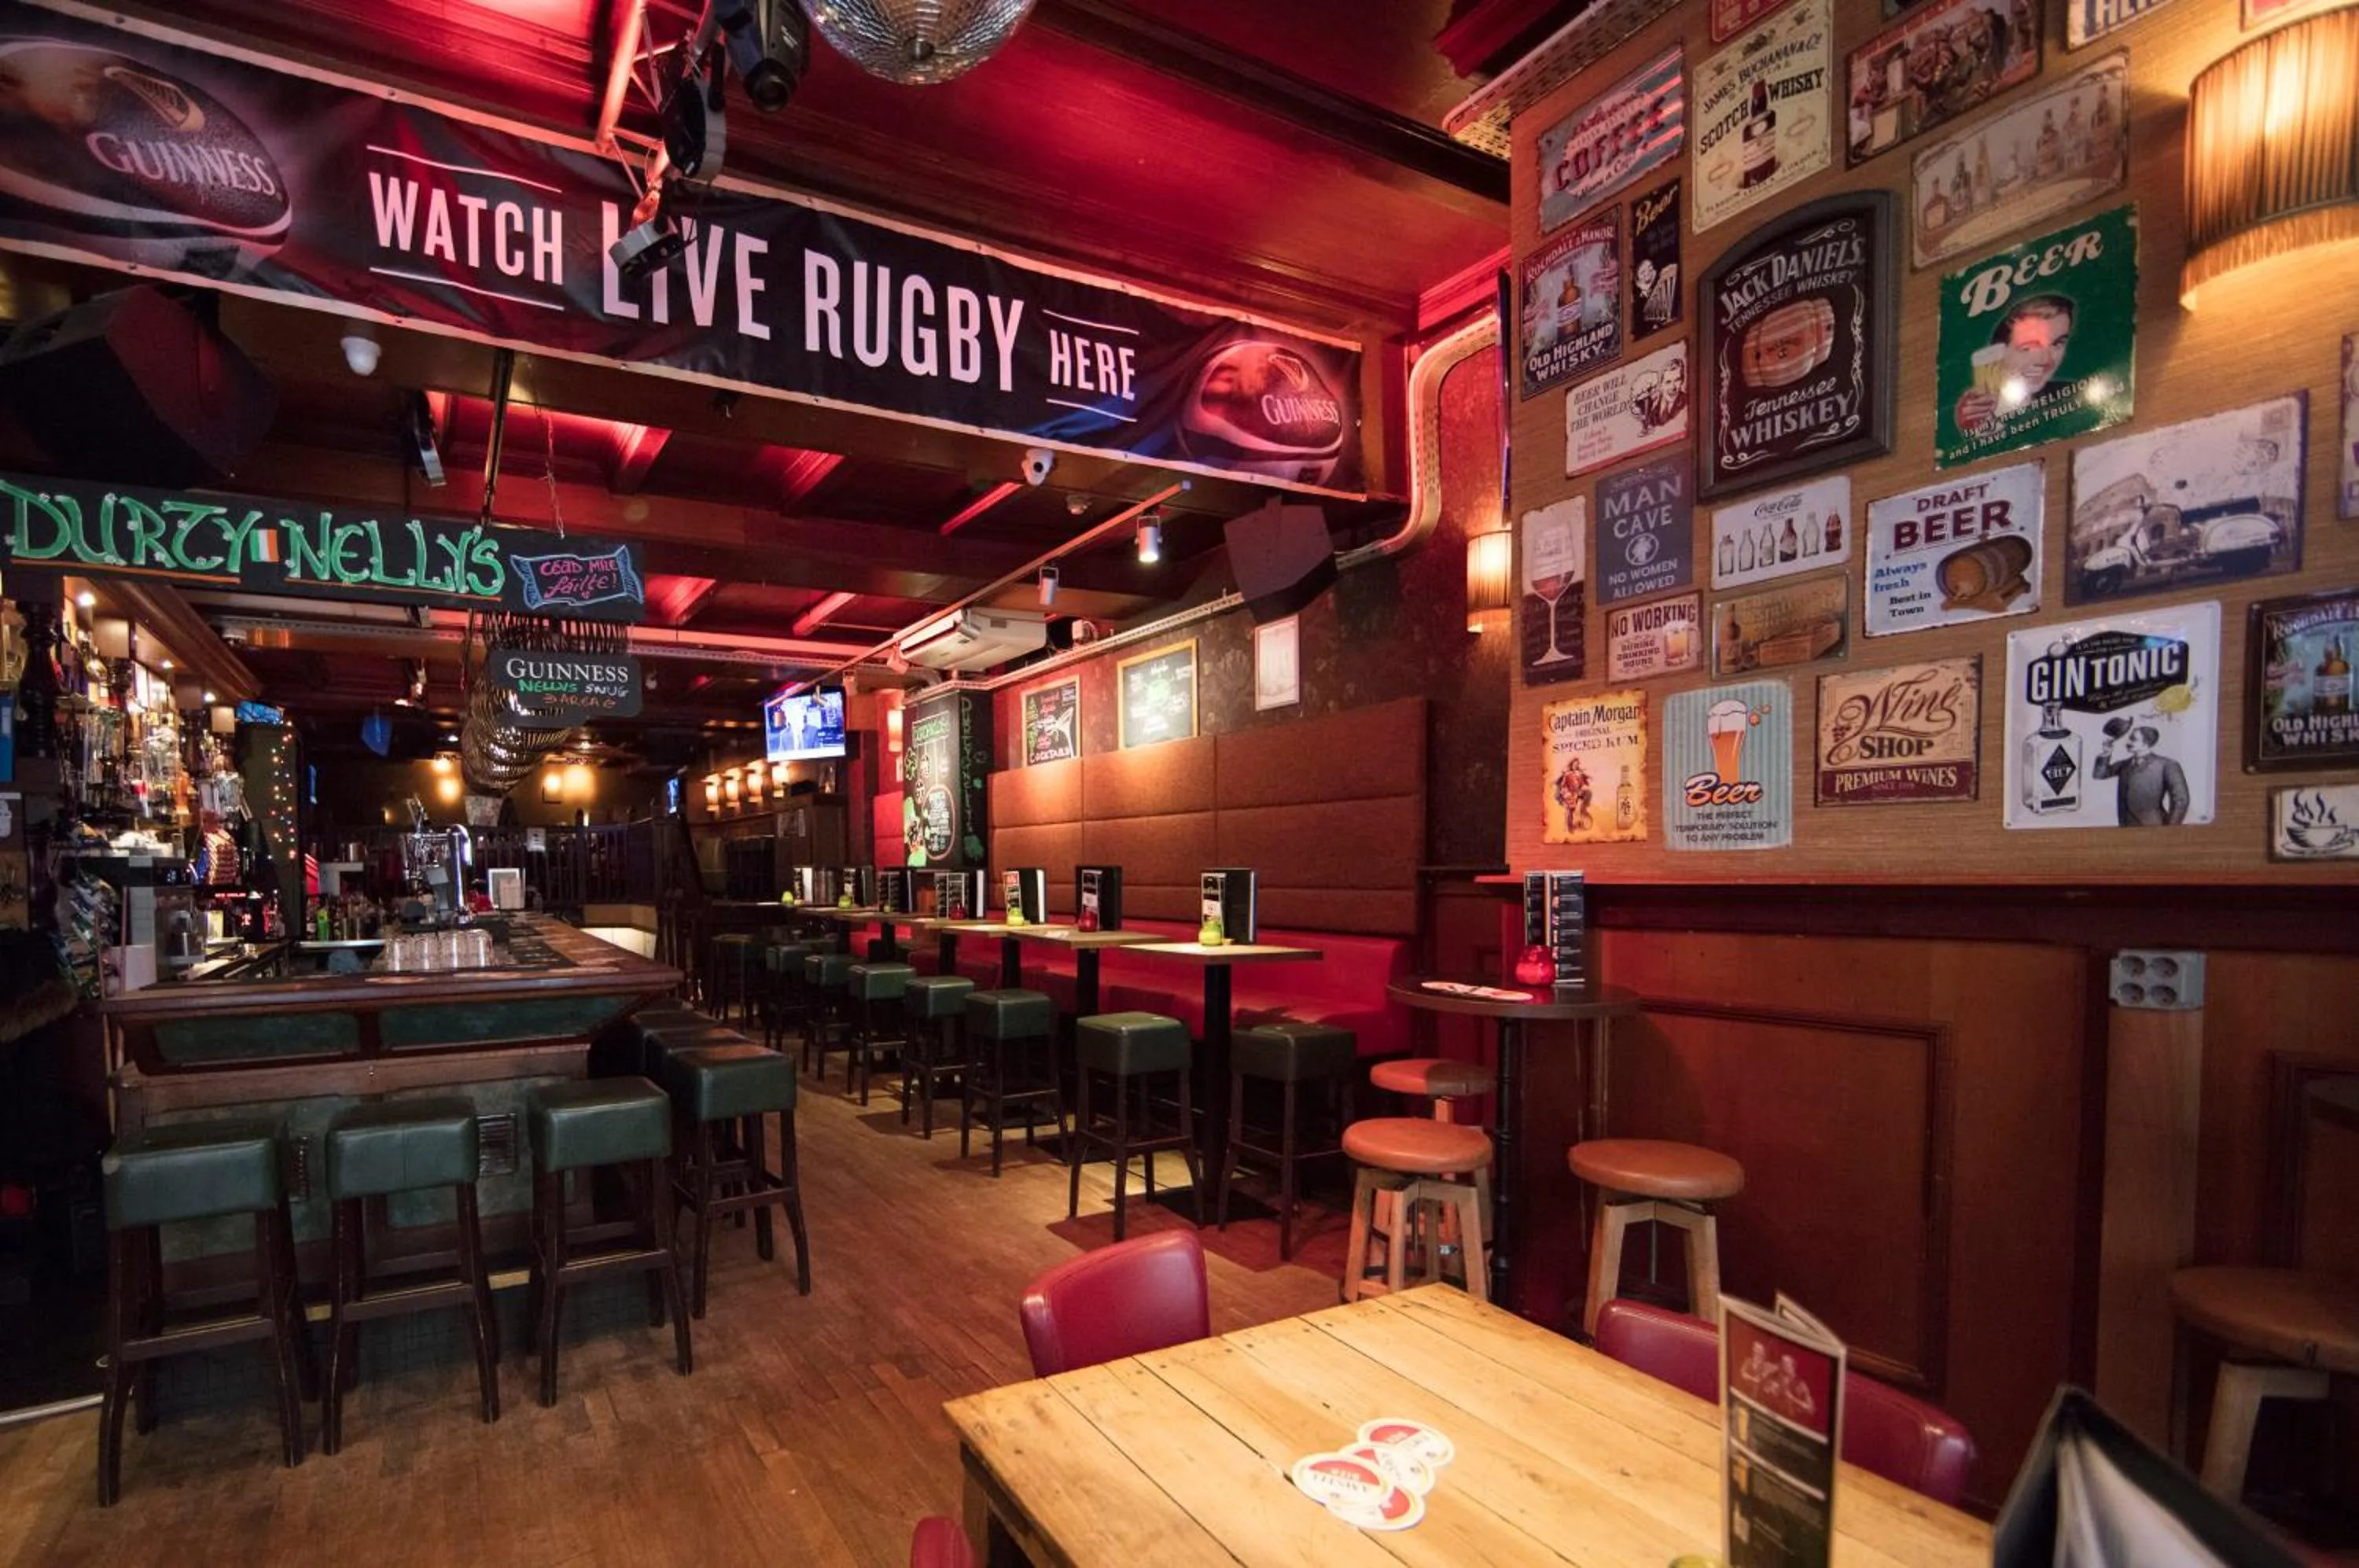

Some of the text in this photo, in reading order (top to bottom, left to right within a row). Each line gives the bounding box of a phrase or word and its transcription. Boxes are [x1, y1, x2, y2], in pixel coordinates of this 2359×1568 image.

[1700, 98, 1750, 156] SCOTCH
[1768, 67, 1825, 103] WHISKY
[1703, 82, 1736, 114] JAMES
[1555, 96, 1665, 191] COFFEE
[86, 131, 277, 197] GUINNESS
[1581, 225, 1614, 243] MANOR
[367, 171, 564, 285] WATCH
[804, 248, 1025, 393] RUGBY
[1049, 328, 1135, 402] HERE
[1719, 231, 1865, 325] JACK DANIEL'S
[1960, 230, 2104, 318] BEER
[1726, 271, 1858, 334] TENNESSEE WHISKEY
[1529, 323, 1614, 372] OLD HIGHLAND
[1261, 393, 1340, 428] GUINNESS
[1577, 392, 1620, 417] CHANGE
[1744, 376, 1838, 421] Tennessee
[1571, 418, 1589, 432] THE
[1730, 389, 1854, 450] WHISKEY
[1949, 441, 1969, 460] and
[1979, 429, 2008, 447] have
[2011, 418, 2040, 434] been
[2043, 399, 2084, 421] TRULY
[1604, 475, 1683, 520] MAN
[1916, 482, 1989, 513] DRAFT
[1614, 504, 1673, 539] CAVE
[1893, 499, 2013, 550] BEER
[0, 478, 506, 597] DURTY NELLY'S
[1609, 558, 1679, 586] NO WOMEN
[1874, 561, 1928, 580] Always
[1874, 578, 1911, 593] fresh
[1613, 575, 1676, 598] ALLOWED
[1890, 590, 1932, 605] Best in
[1610, 616, 1628, 639] NO
[1632, 602, 1696, 634] WORKING
[1889, 605, 1925, 617] Town
[1616, 646, 1662, 661] DRINKING
[1621, 639, 1656, 652] DURING
[506, 657, 629, 683] GUINNESS
[2030, 656, 2086, 702] GIN
[2089, 644, 2181, 690] TONIC
[584, 684, 629, 698] SNUG
[1548, 704, 1643, 734] Captain Morgan
[2272, 717, 2305, 733] OLD
[1606, 734, 1640, 749] RUM
[1859, 734, 1934, 760] SHOP
[1684, 771, 1764, 808] Beer
[1835, 769, 1901, 793] PREMIUM
[1904, 766, 1958, 787] WINES
[1675, 820, 1779, 833] TEMPORARY SOLUTION
[1696, 810, 1754, 820] THE PERFECT
[1686, 832, 1765, 842] TO ANY PROBLEM
